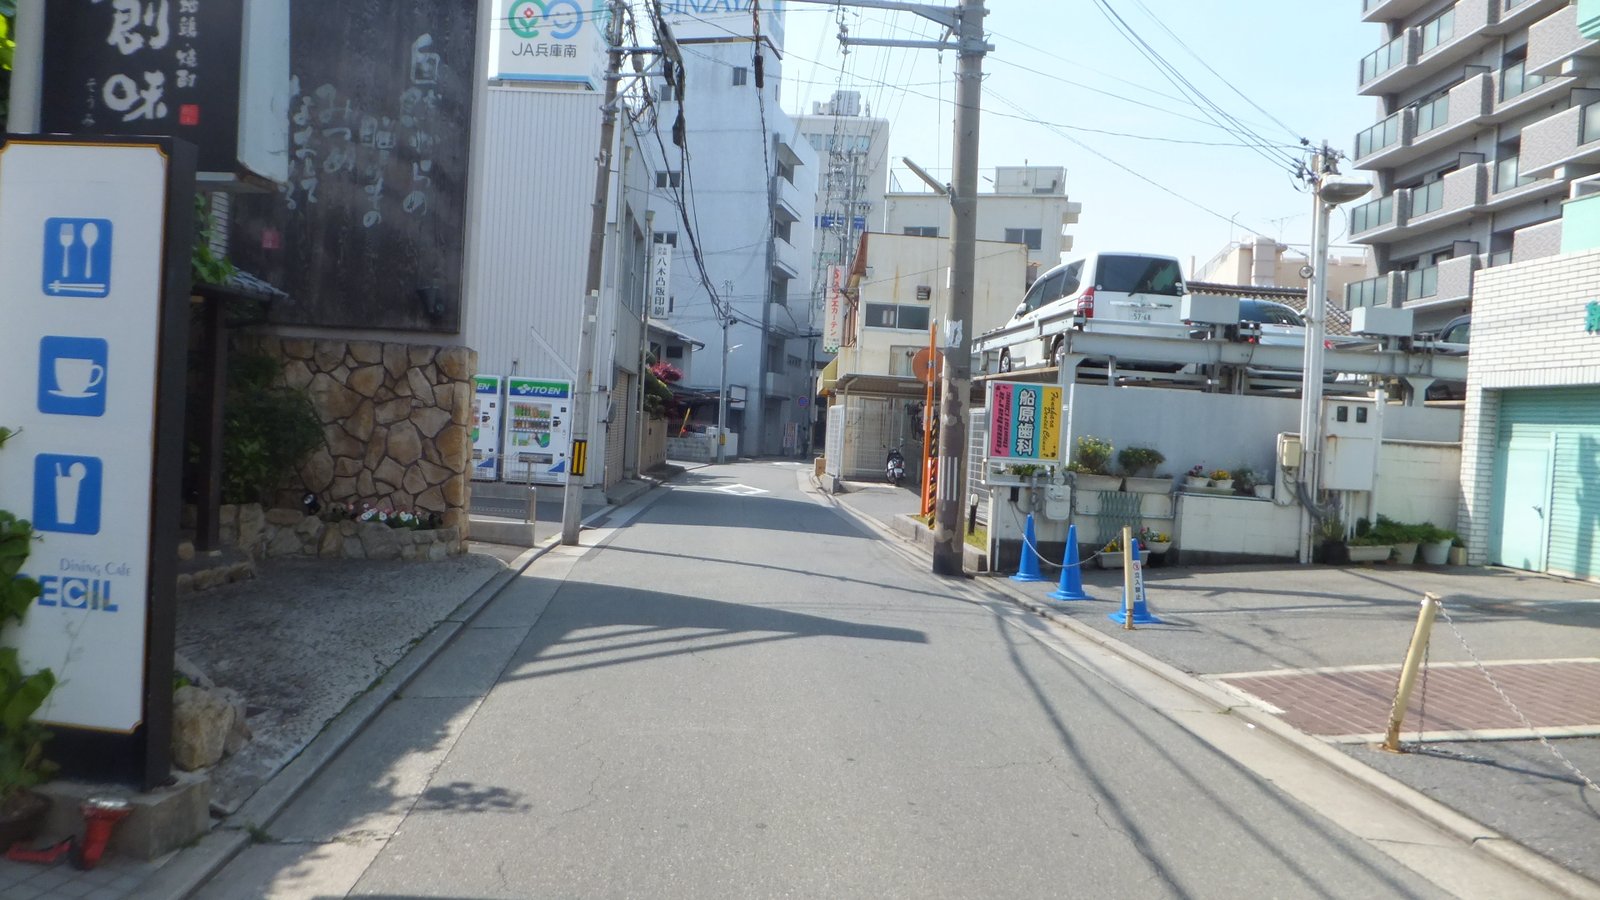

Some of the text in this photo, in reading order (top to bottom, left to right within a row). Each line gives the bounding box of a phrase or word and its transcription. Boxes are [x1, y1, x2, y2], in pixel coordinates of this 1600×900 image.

[511, 43, 577, 58] JA兵庫南
[653, 257, 668, 317] 八木凸版印刷
[477, 383, 490, 391] EN
[1016, 388, 1036, 456] 船原歯科
[60, 558, 101, 577] Dining
[14, 574, 118, 612] ECIL
